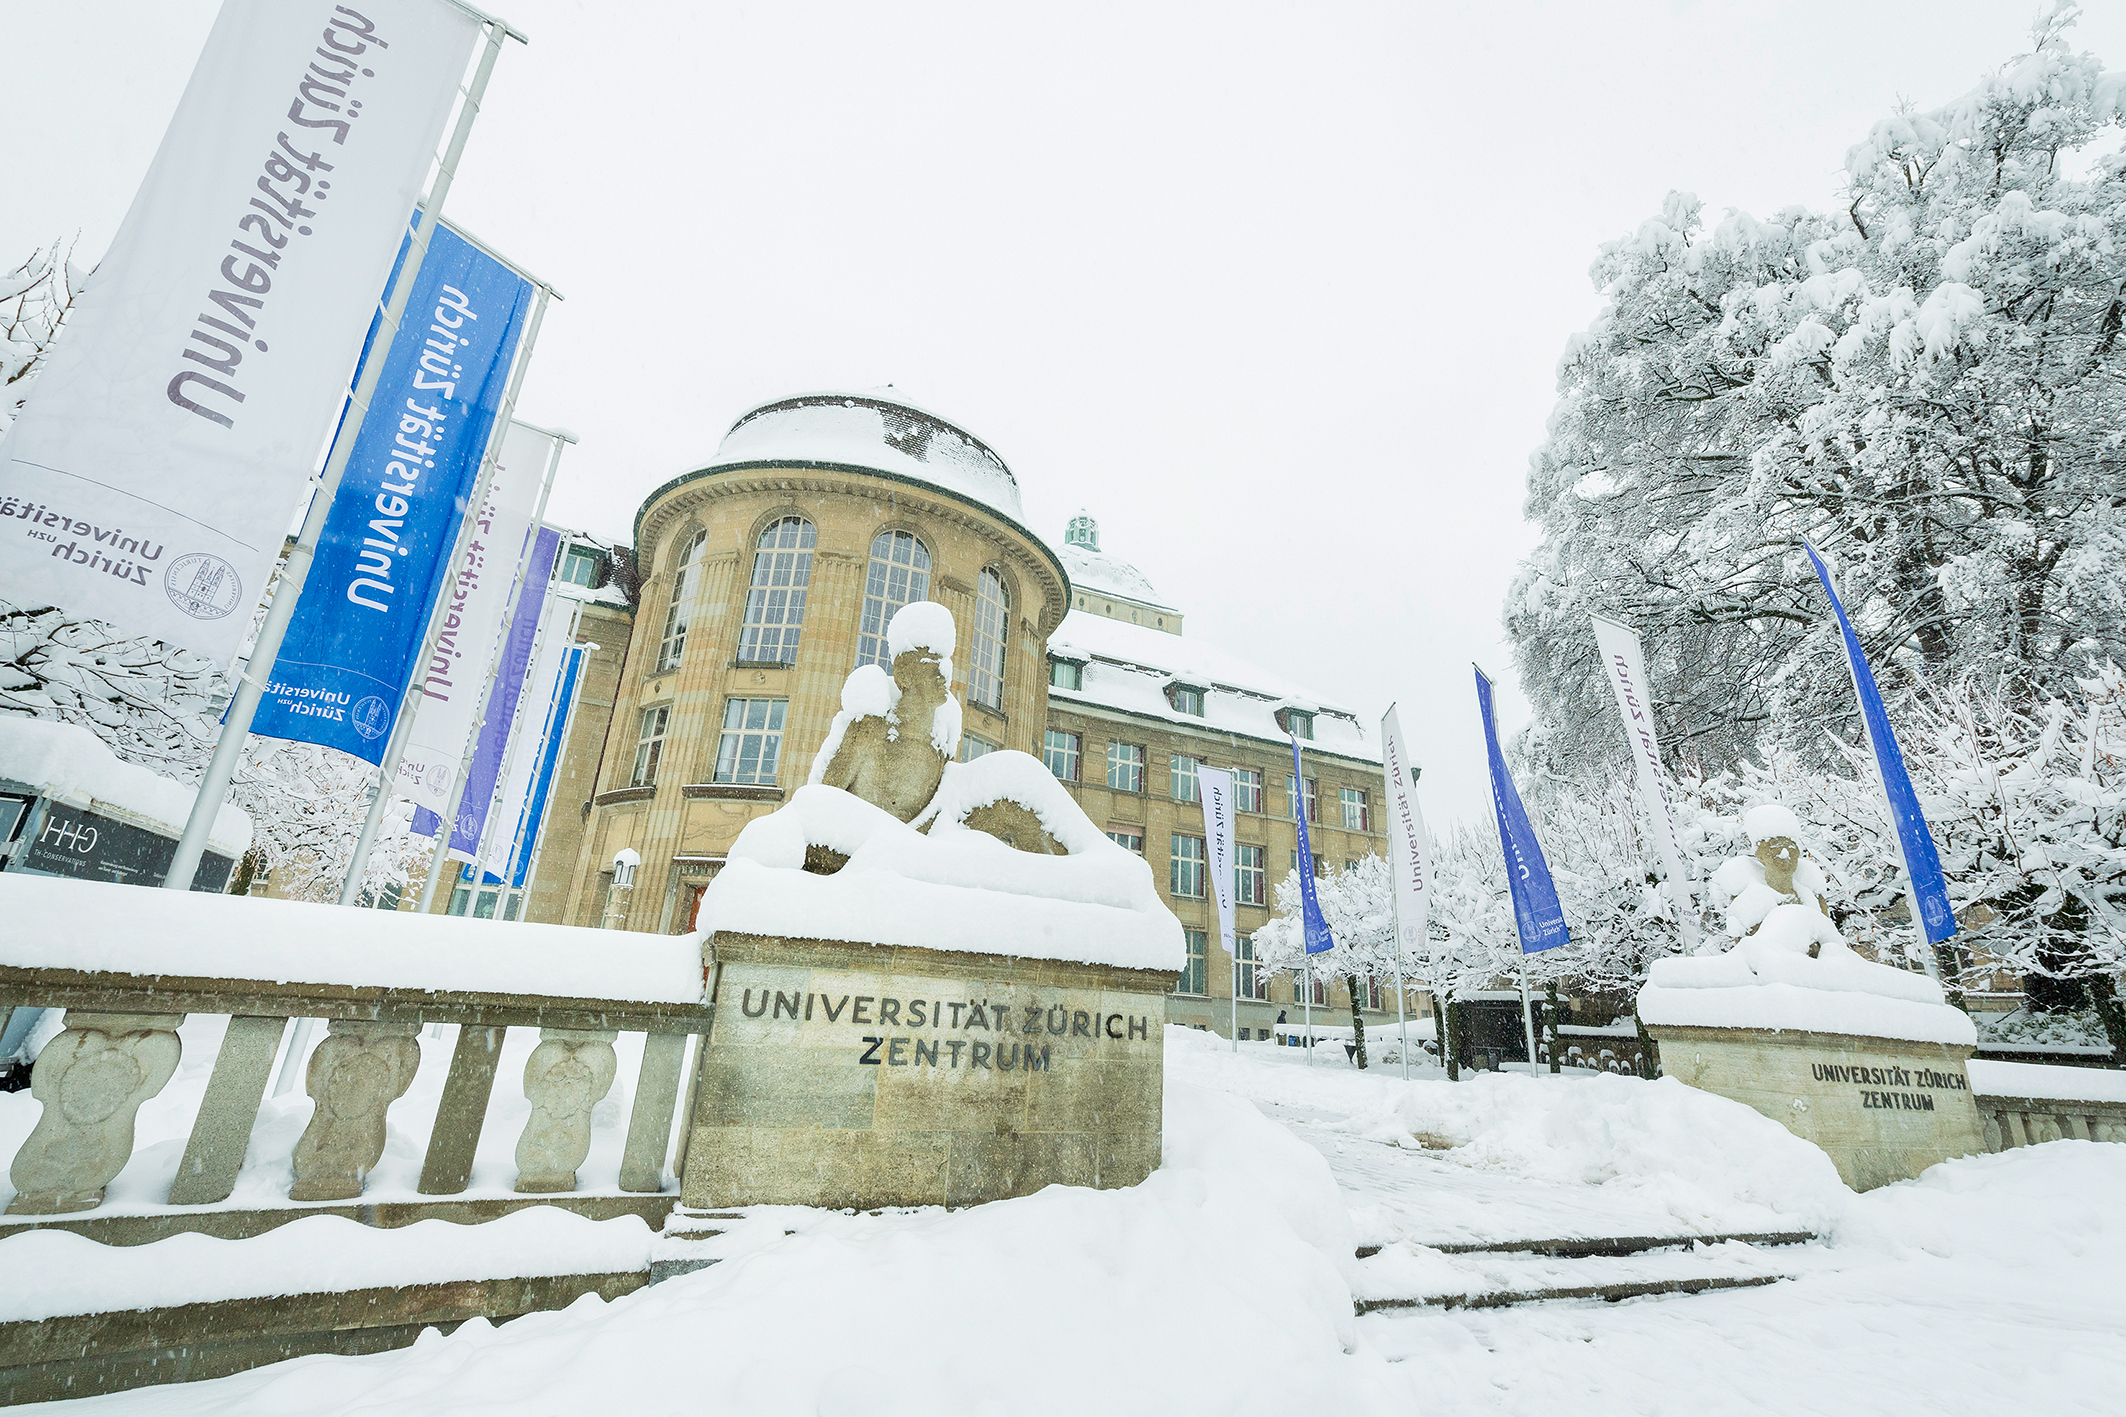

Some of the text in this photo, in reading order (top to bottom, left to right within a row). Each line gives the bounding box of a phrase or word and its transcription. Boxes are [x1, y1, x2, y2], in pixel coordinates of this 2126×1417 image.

[1388, 735, 1424, 892] Universität Zürich
[742, 988, 1147, 1041] UNIVERSITÄT ZÜRICH
[859, 1036, 1051, 1073] ZENTRUM
[1811, 1063, 1967, 1090] UNIVERSITÄT ZÜRICH
[1860, 1090, 1935, 1111] ZENTRUM
